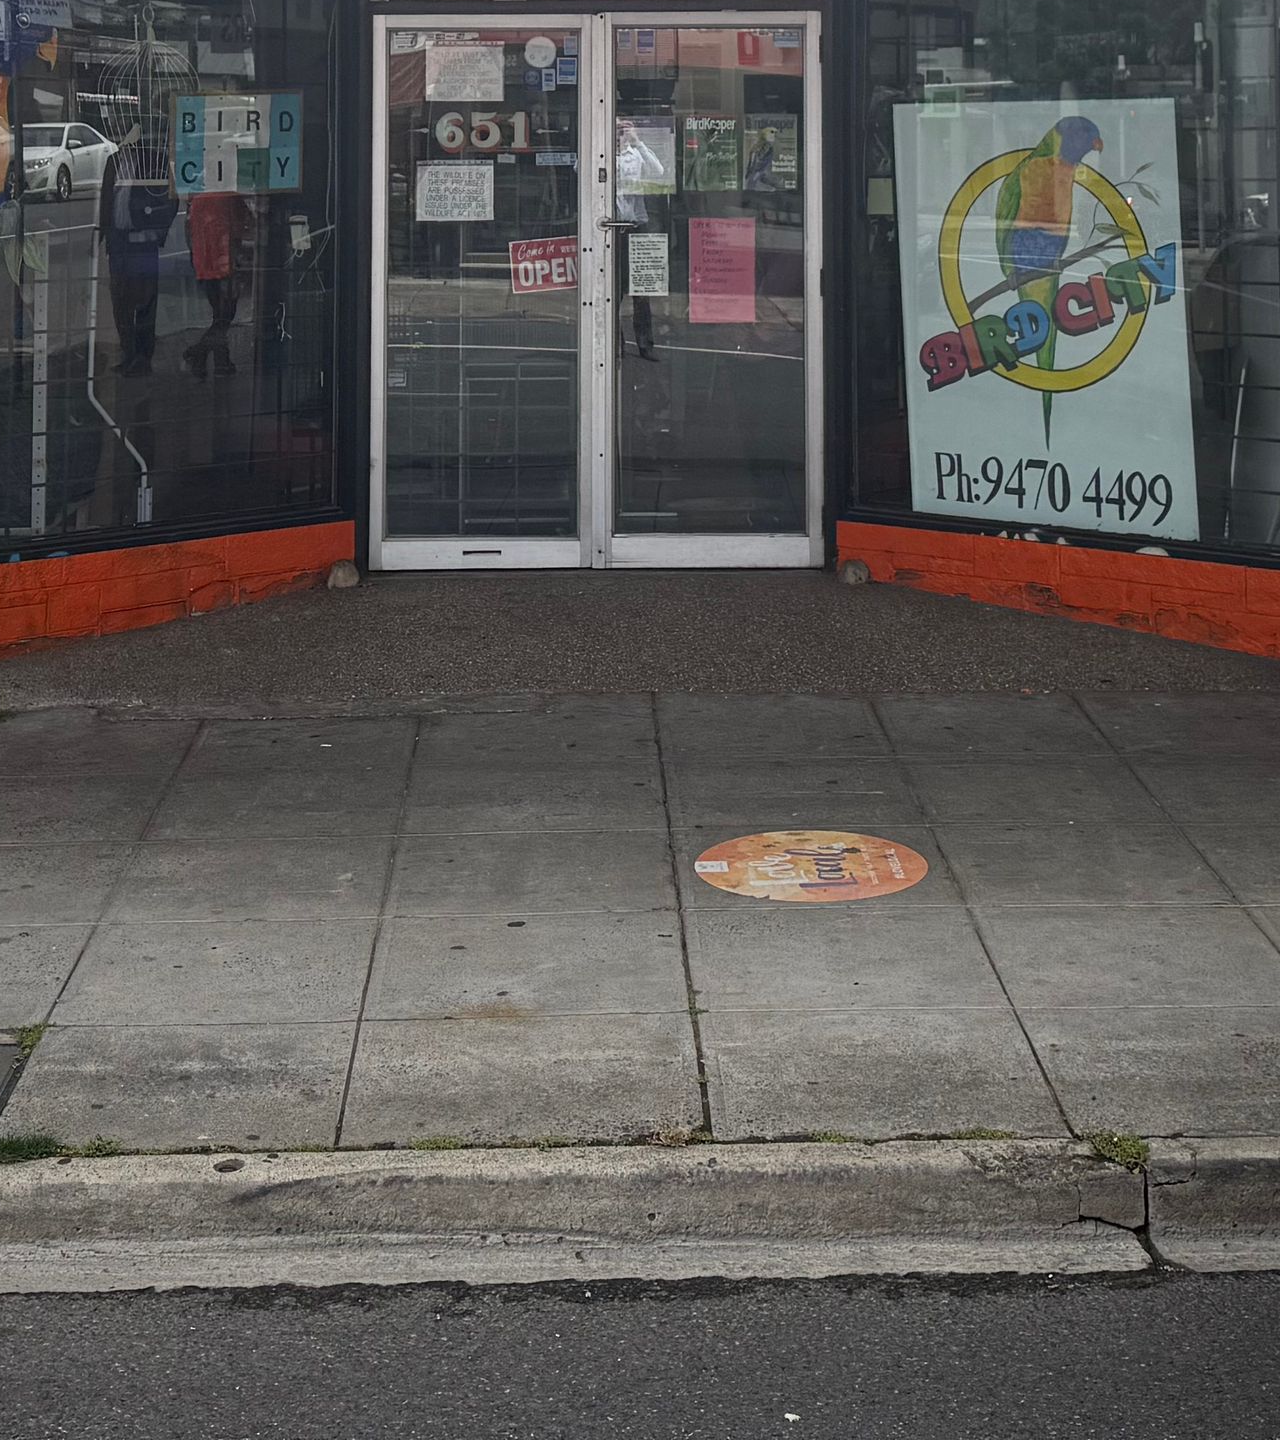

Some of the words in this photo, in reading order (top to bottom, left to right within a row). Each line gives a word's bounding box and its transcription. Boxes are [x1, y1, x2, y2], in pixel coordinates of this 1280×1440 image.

[182, 110, 294, 134] BIRD
[435, 111, 531, 154] 651
[181, 156, 291, 184] CITY
[517, 243, 544, 261] Come
[546, 241, 555, 255] in
[919, 300, 1050, 392] BIRD
[1052, 242, 1177, 337] CITY
[1082, 466, 1173, 527] 4499
